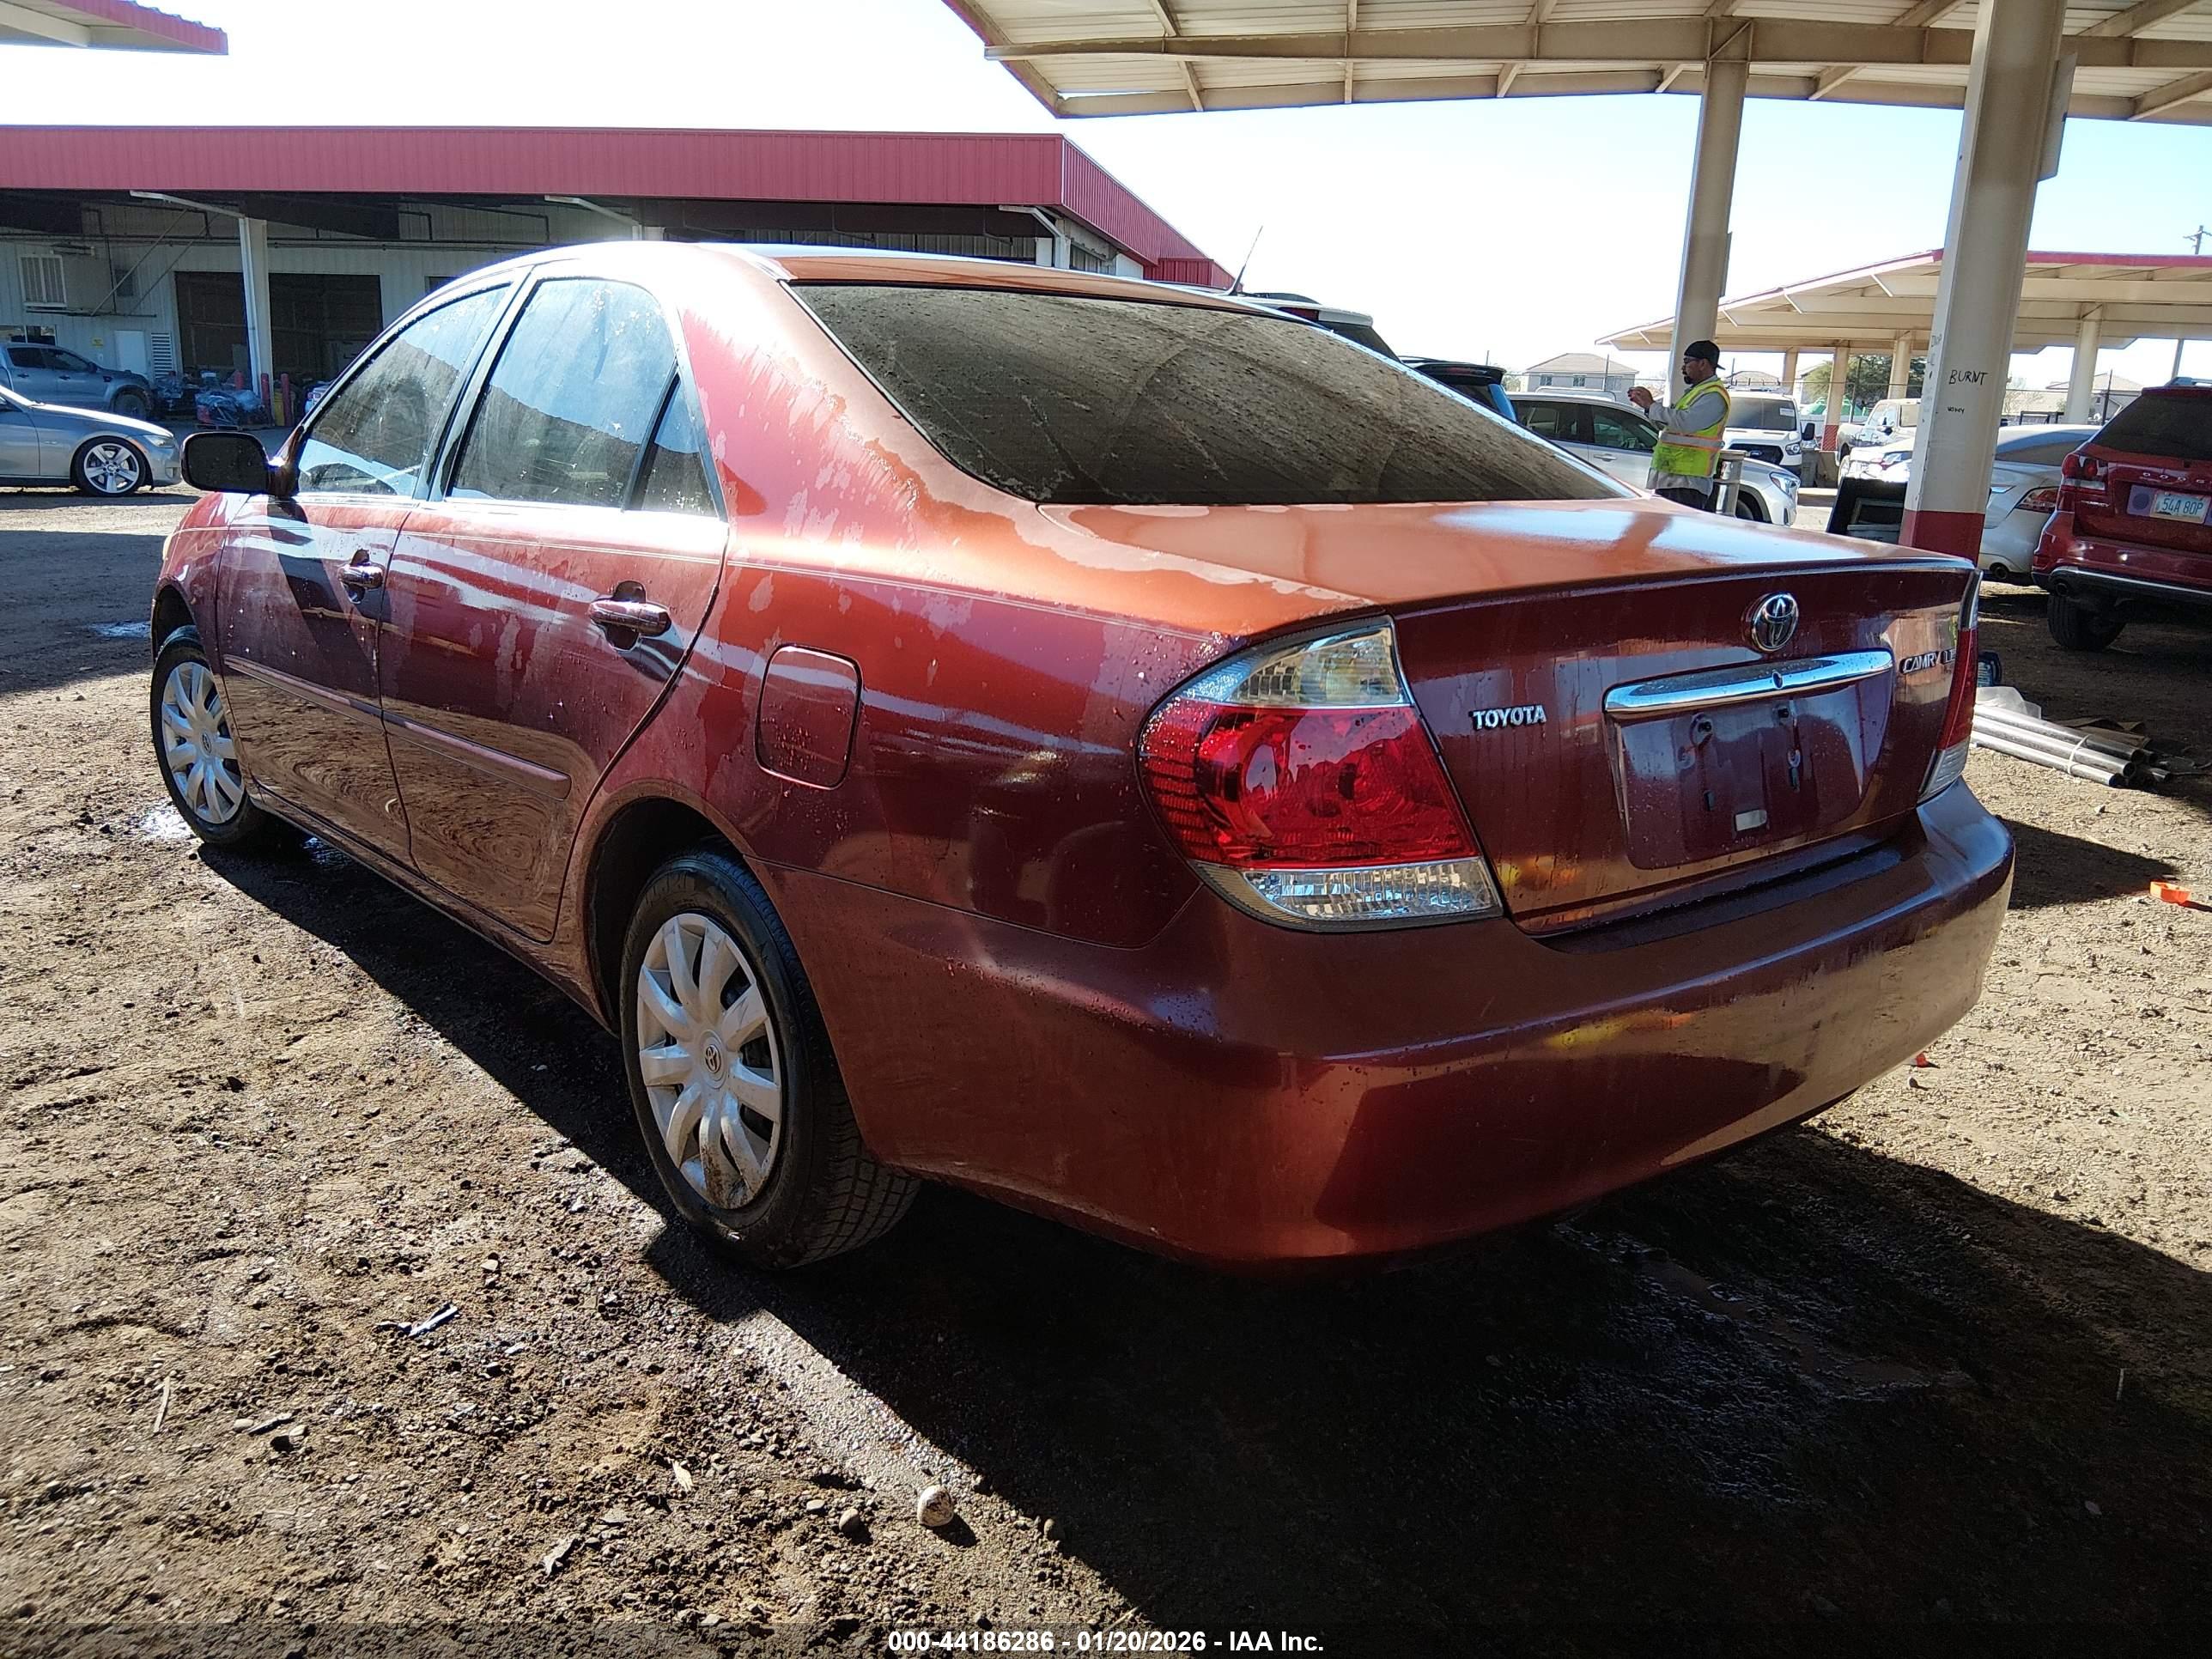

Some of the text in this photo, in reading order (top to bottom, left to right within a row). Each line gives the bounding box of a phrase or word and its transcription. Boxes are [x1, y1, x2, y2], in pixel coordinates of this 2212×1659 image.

[1949, 369, 1989, 386] BURNT
[1902, 651, 1942, 673] CAMRY
[1472, 704, 1547, 730] TOYOTA
